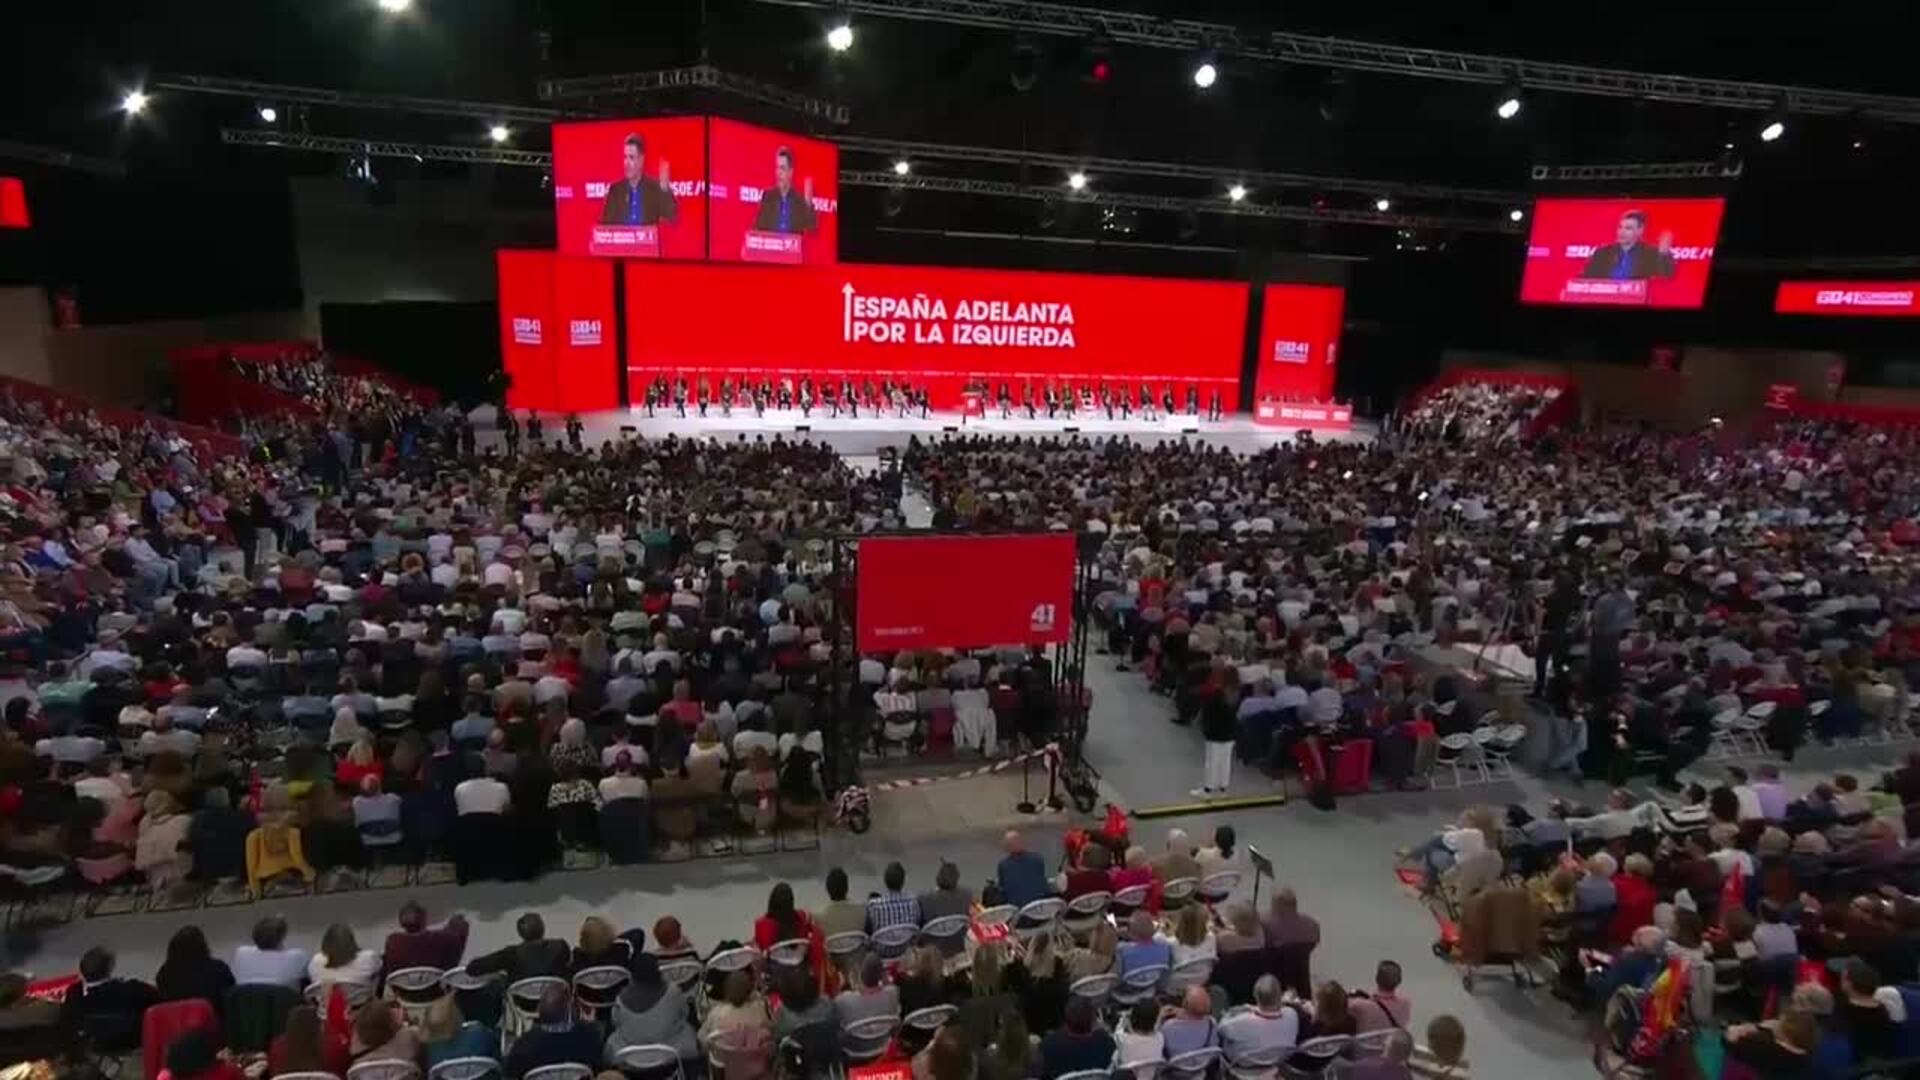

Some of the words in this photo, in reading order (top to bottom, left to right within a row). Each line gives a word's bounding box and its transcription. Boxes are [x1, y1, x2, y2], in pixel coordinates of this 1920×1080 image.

[853, 293, 948, 320] ESPAÑA
[954, 299, 1074, 325] ADELANTA
[853, 320, 906, 343] POR
[914, 322, 945, 344] LA
[952, 323, 1075, 348] IZQUIERDA
[1031, 603, 1055, 623] 41
